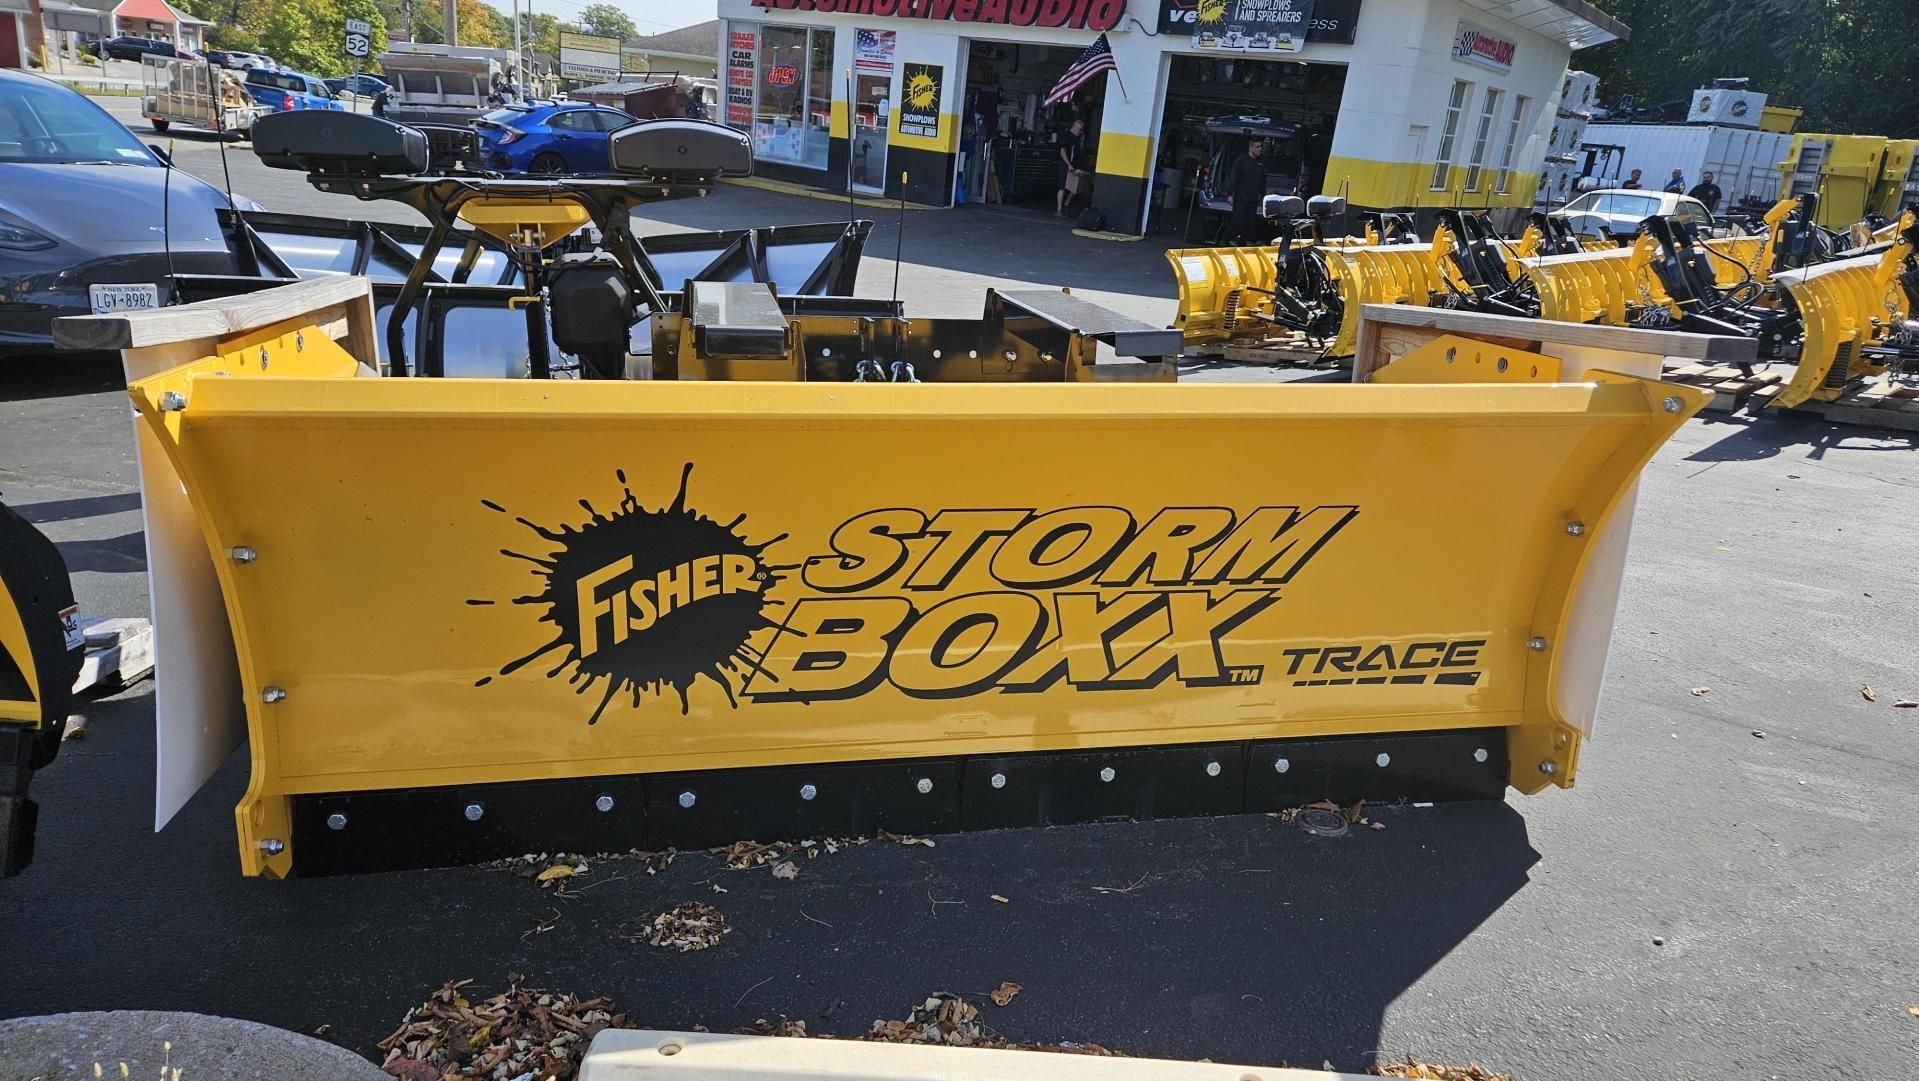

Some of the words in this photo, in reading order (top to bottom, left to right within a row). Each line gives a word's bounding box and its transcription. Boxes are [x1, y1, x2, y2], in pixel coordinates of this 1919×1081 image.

[1241, 0, 1291, 11] SNOWPLOWS
[1239, 9, 1256, 21] AND
[1257, 10, 1302, 23] SPREADERS
[350, 21, 367, 31] EAST
[348, 37, 367, 53] 52
[732, 51, 751, 60] CAR
[729, 59, 754, 68] ALARMS
[768, 66, 796, 85] OPEN
[746, 89, 753, 97] RV
[912, 84, 934, 101] FISHER
[728, 95, 752, 105] RADIOS
[903, 113, 936, 125] SNOWPLOWS
[801, 505, 1360, 593] STORM
[738, 587, 1283, 704] BOXX
[1282, 639, 1487, 675] TRACE
